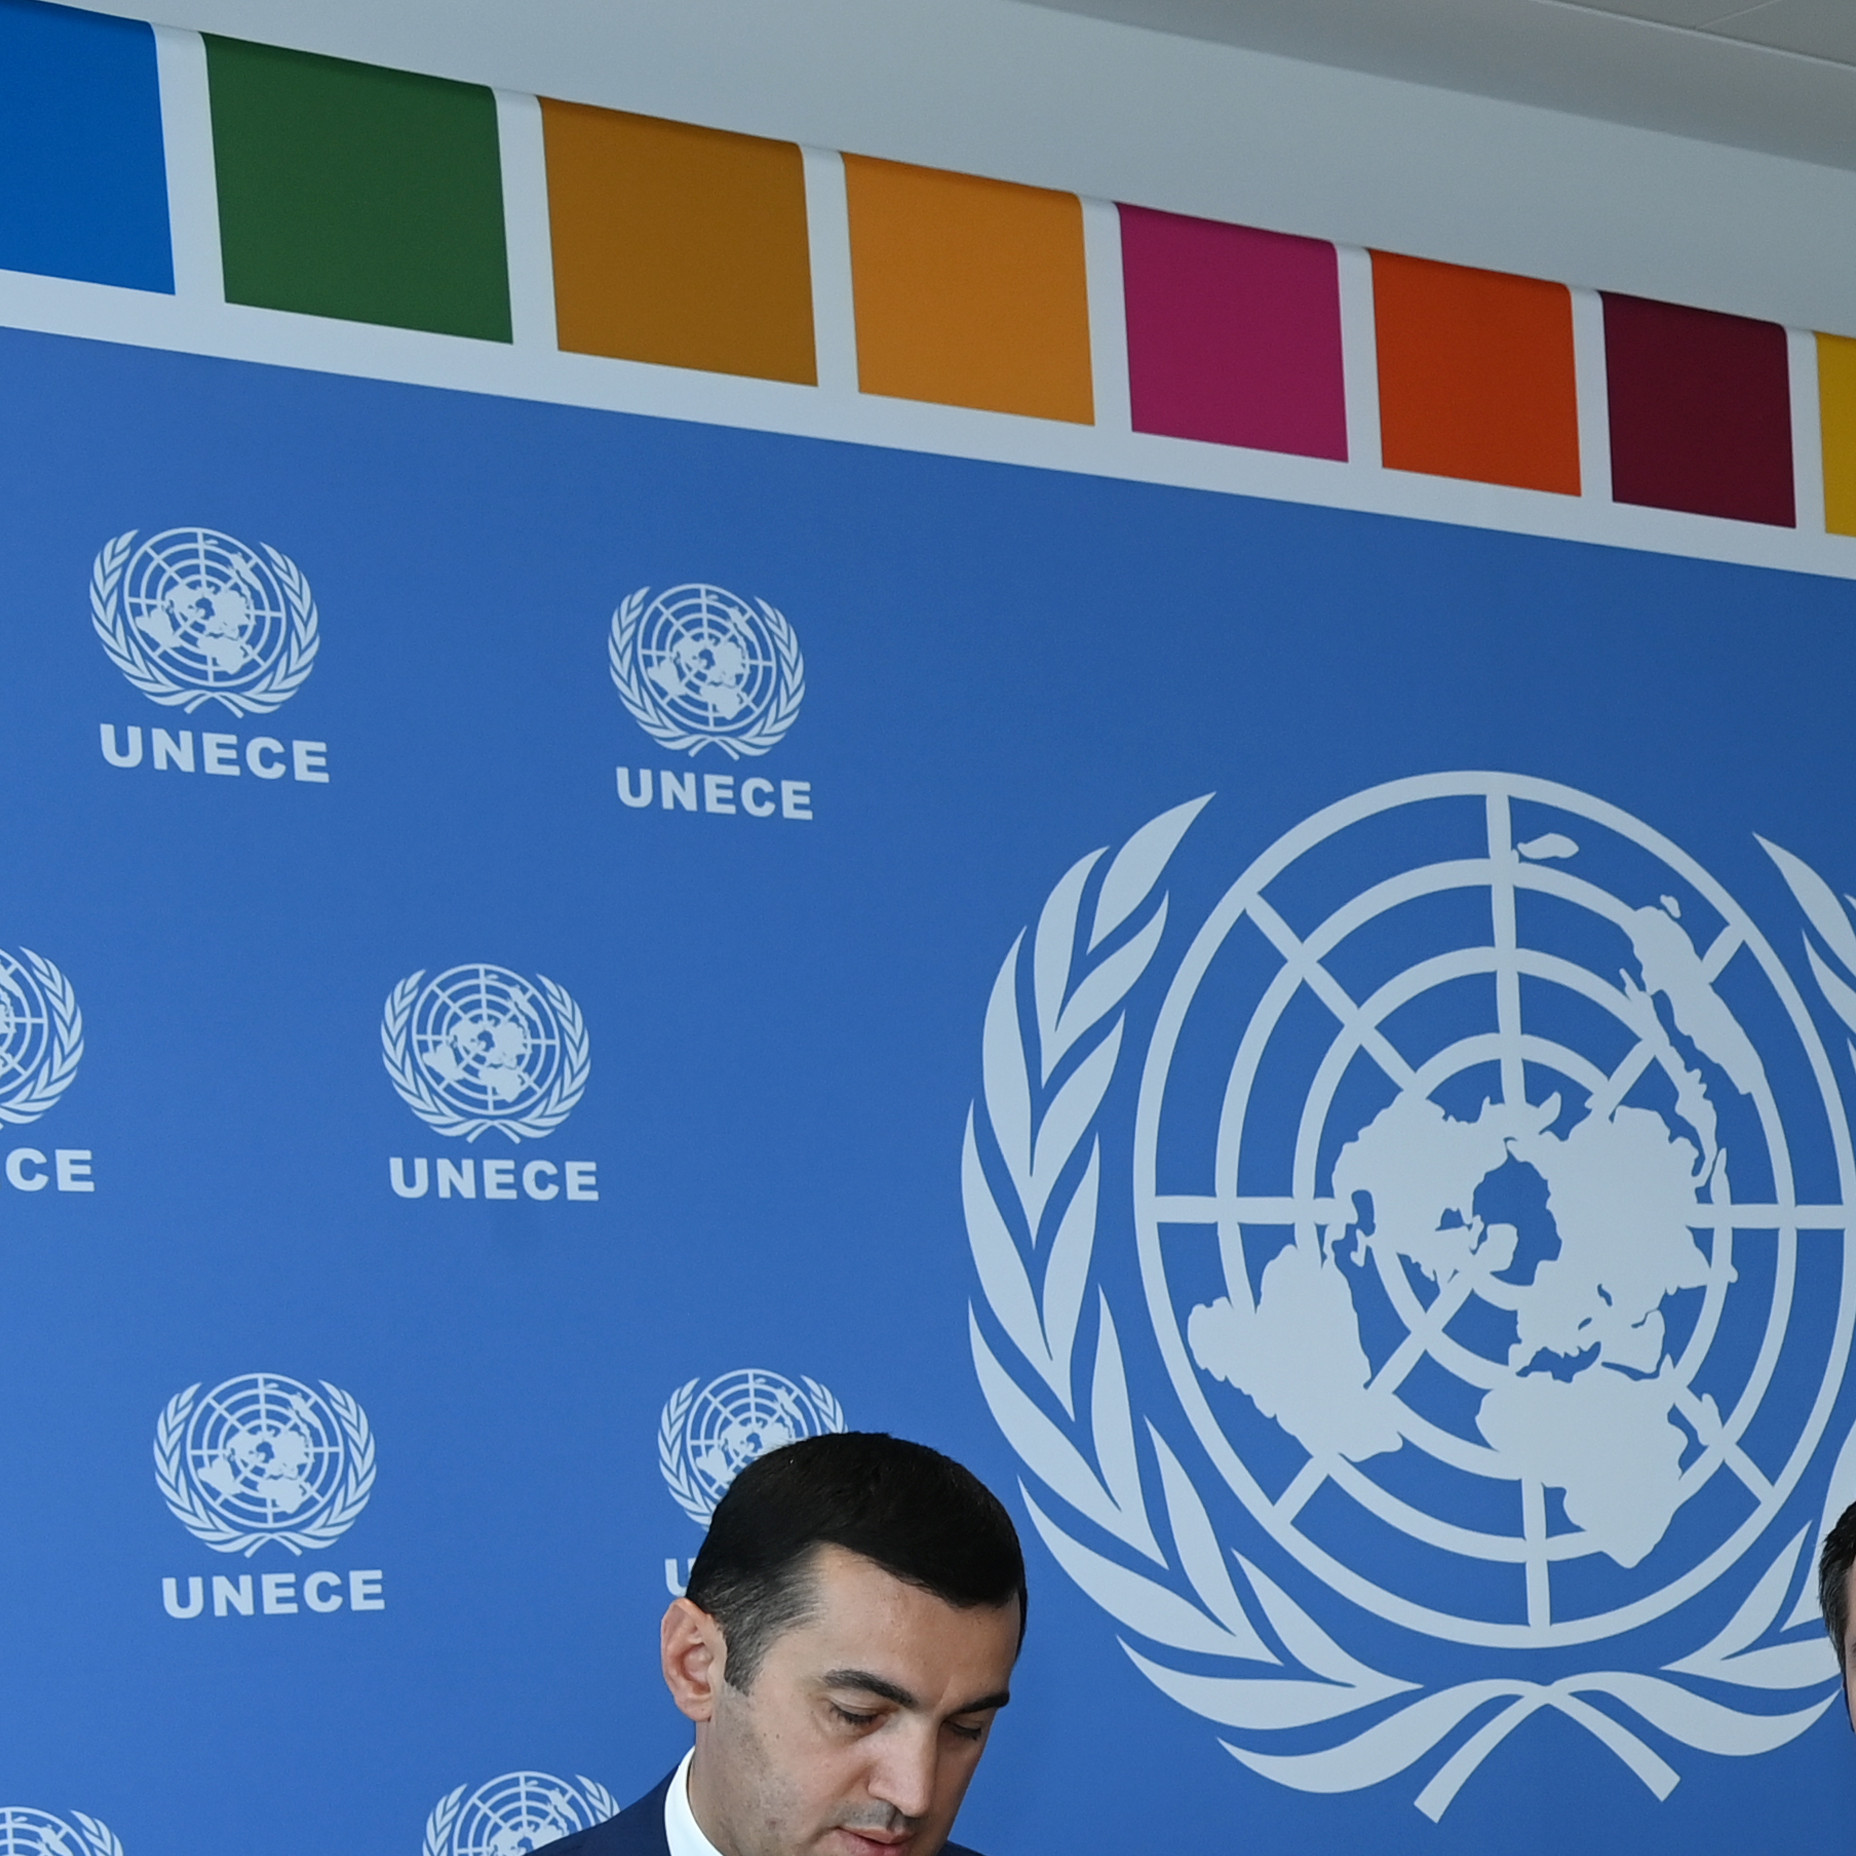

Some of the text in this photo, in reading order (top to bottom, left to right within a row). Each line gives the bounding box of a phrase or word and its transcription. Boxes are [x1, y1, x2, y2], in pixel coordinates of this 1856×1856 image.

[100, 724, 329, 783] UNECE
[617, 767, 813, 820] UNECE
[390, 1157, 599, 1201] UNECE
[163, 1570, 385, 1618] UNECE
